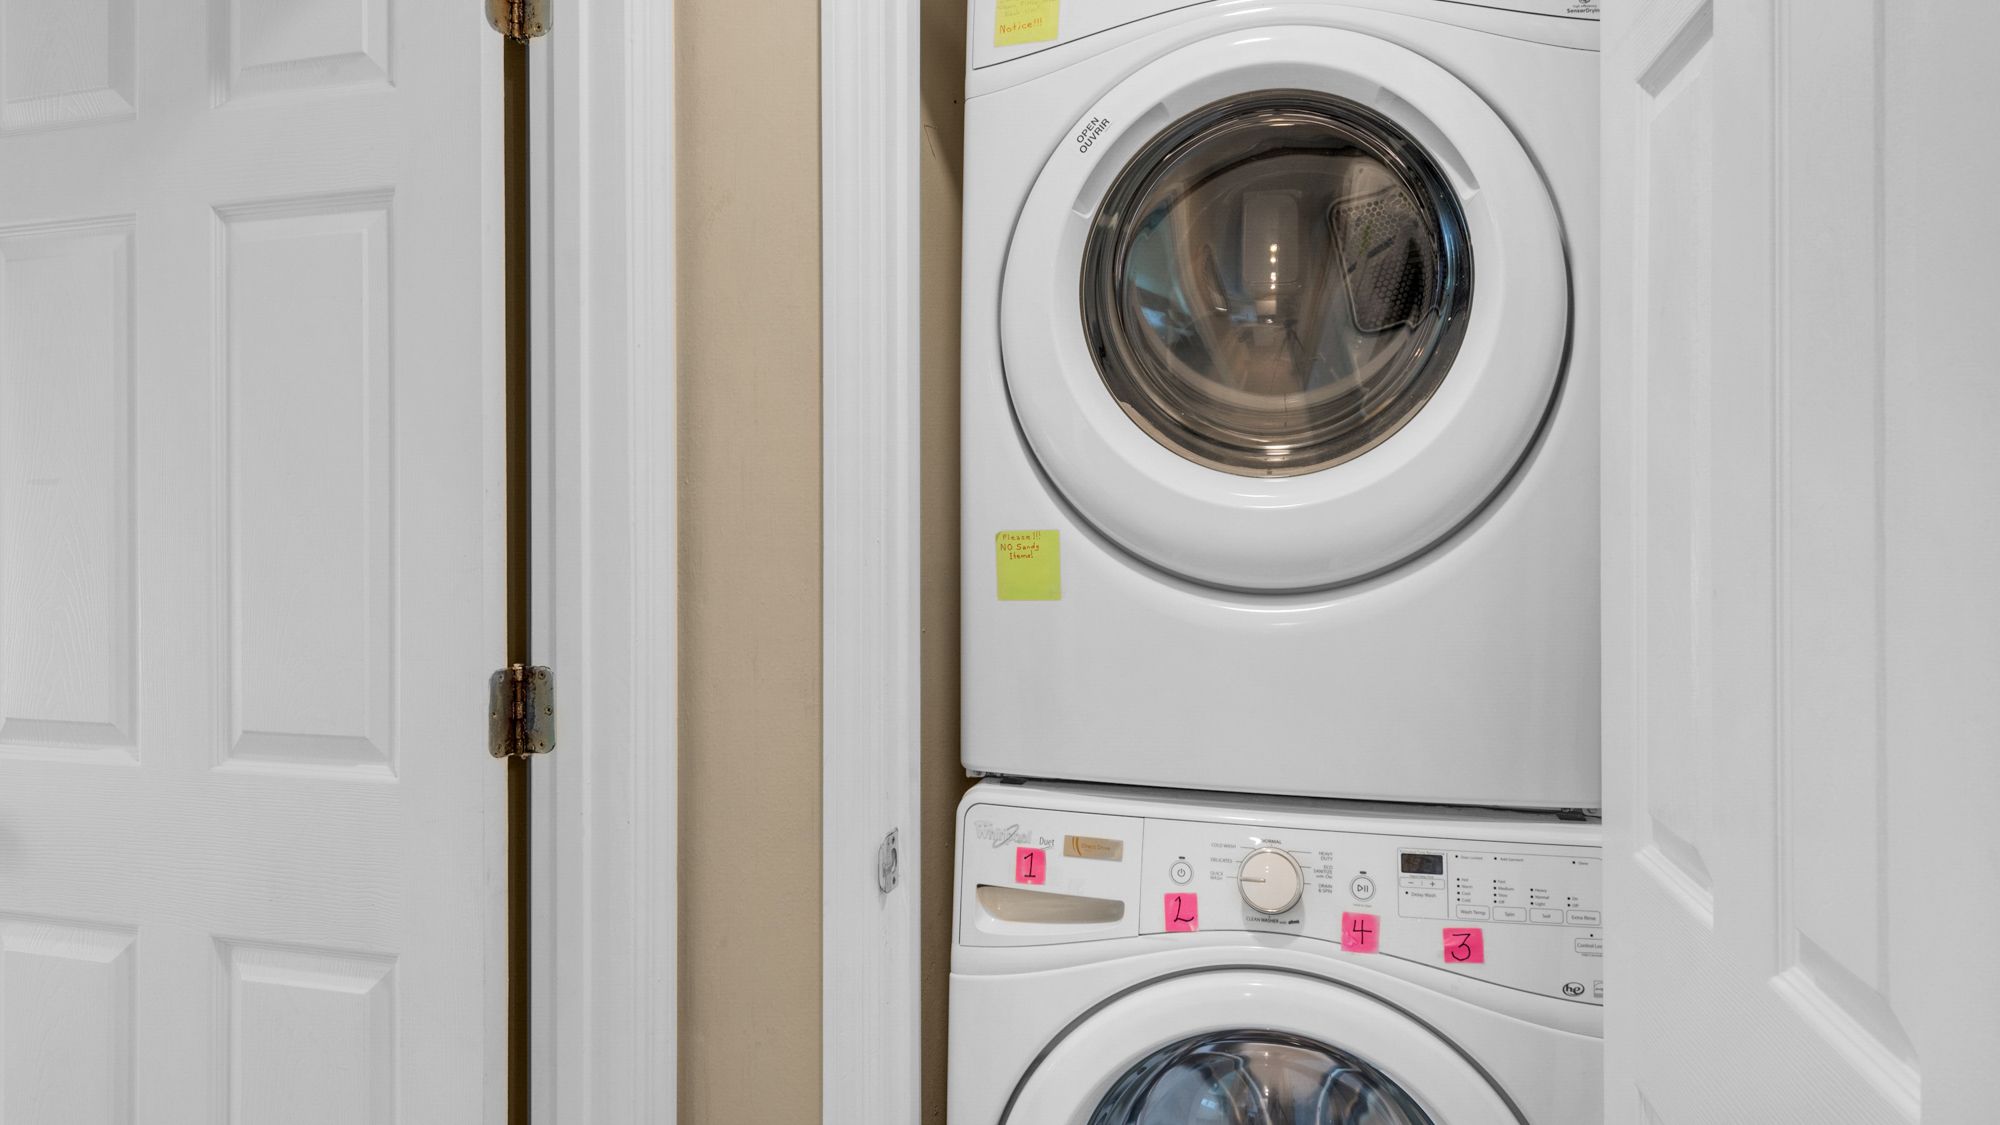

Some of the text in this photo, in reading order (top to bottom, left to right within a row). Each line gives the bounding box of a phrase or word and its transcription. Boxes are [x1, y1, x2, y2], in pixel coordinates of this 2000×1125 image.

[1077, 117, 1099, 143] OPEN
[1080, 118, 1110, 153] OUVRIR
[1039, 836, 1055, 848] Duet
[1024, 852, 1037, 878] 1
[1352, 919, 1373, 945] 4
[1451, 933, 1471, 962] 3
